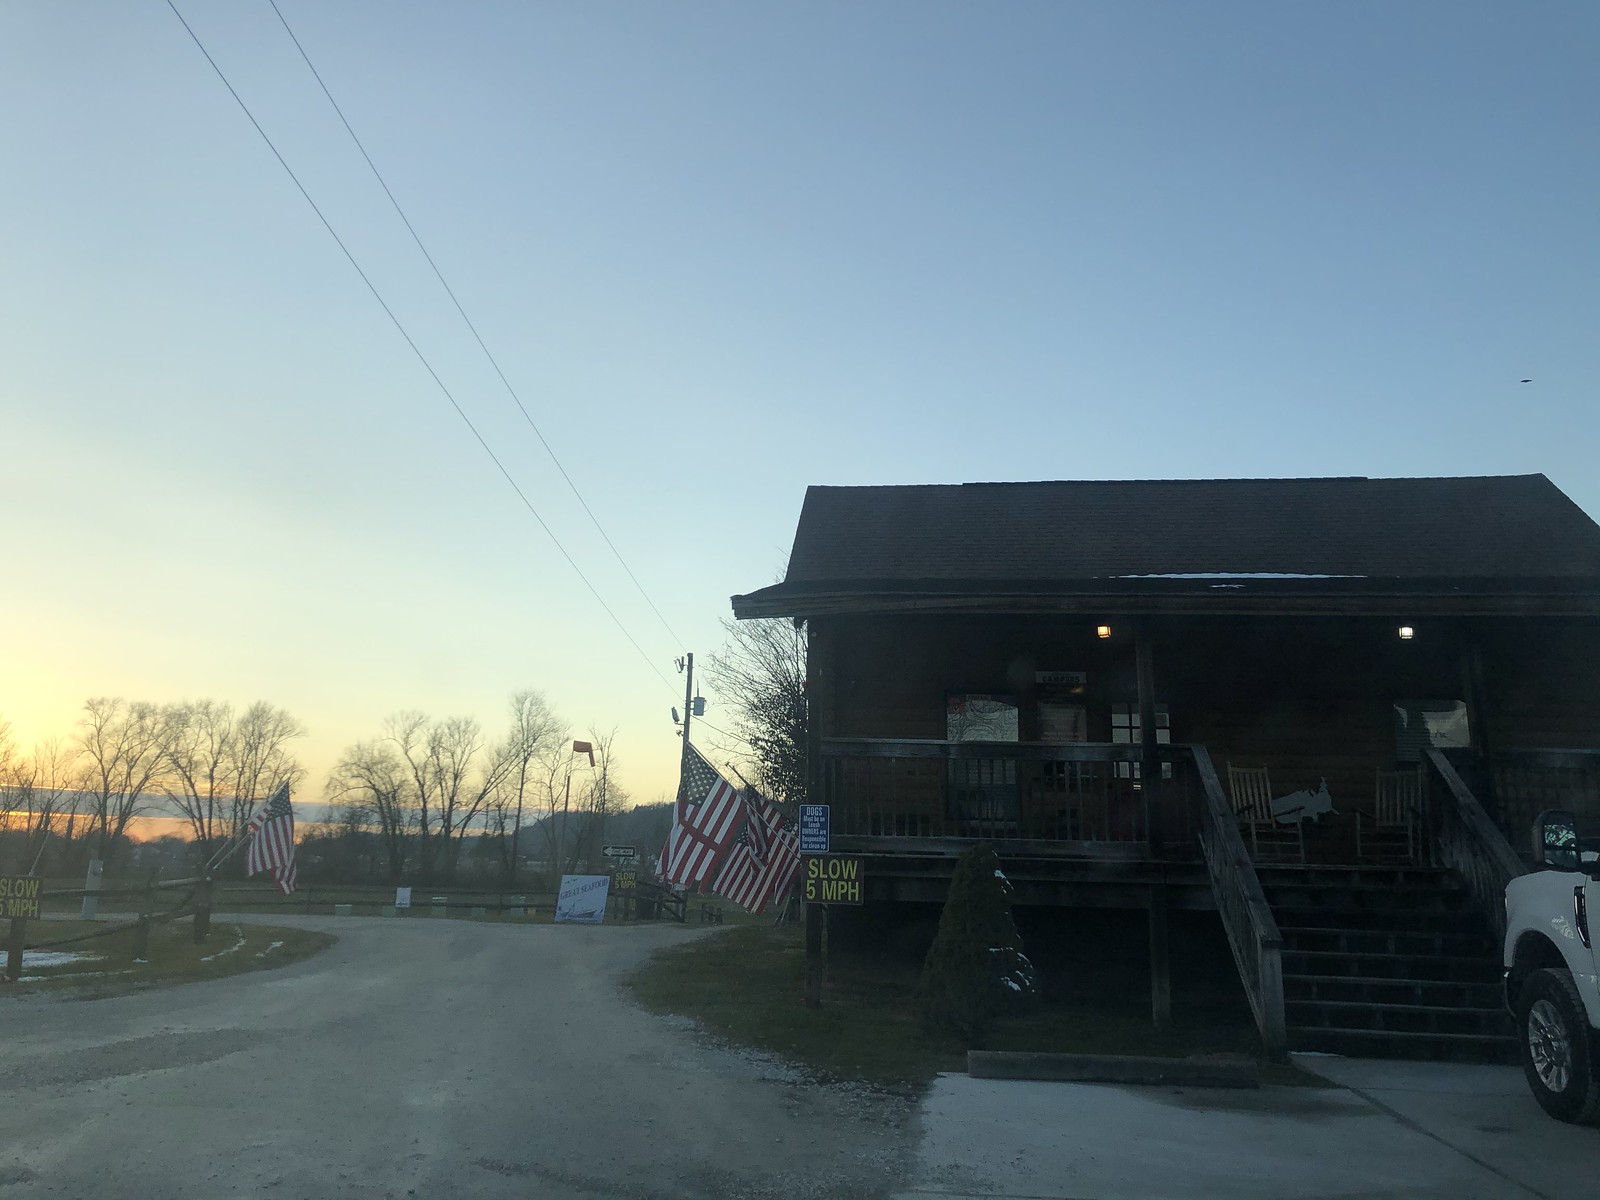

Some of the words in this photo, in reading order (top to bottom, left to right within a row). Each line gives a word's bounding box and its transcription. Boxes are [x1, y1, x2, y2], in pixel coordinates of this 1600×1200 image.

[806, 807, 823, 816] DOGS
[615, 872, 636, 880] SLOW
[808, 858, 858, 880] SLOW
[0, 878, 39, 897] SLOW
[560, 886, 580, 900] GREAT
[581, 878, 608, 892] SEAFOOD
[615, 880, 620, 889] 5
[620, 880, 636, 888] MPH
[806, 879, 816, 900] 5
[822, 880, 859, 901] MPH
[8, 899, 38, 918] MPH
